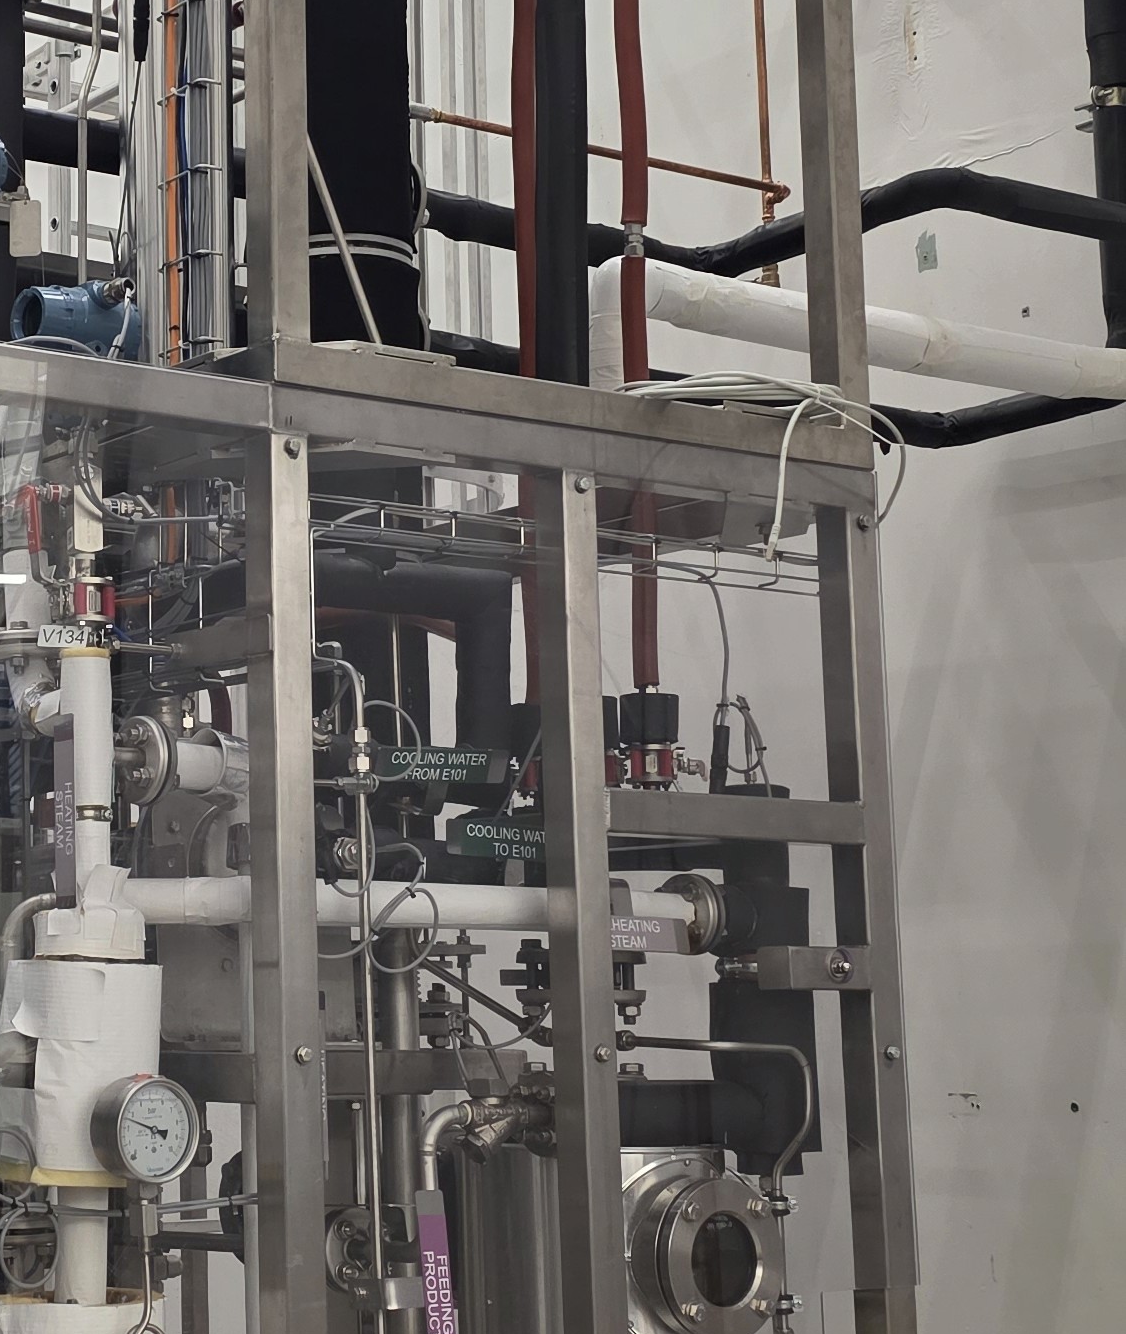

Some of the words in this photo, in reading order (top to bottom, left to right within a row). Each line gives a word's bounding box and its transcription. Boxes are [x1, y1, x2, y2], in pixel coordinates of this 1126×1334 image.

[43, 629, 85, 645] V134
[391, 751, 445, 765] COOLING
[448, 753, 488, 766] WATER
[442, 769, 467, 781] E101
[55, 790, 64, 849] STEAM
[64, 782, 74, 856] HEATING
[466, 823, 521, 840] COOLING
[493, 842, 510, 856] TO
[512, 845, 536, 859] E101
[610, 934, 647, 949] STEAM
